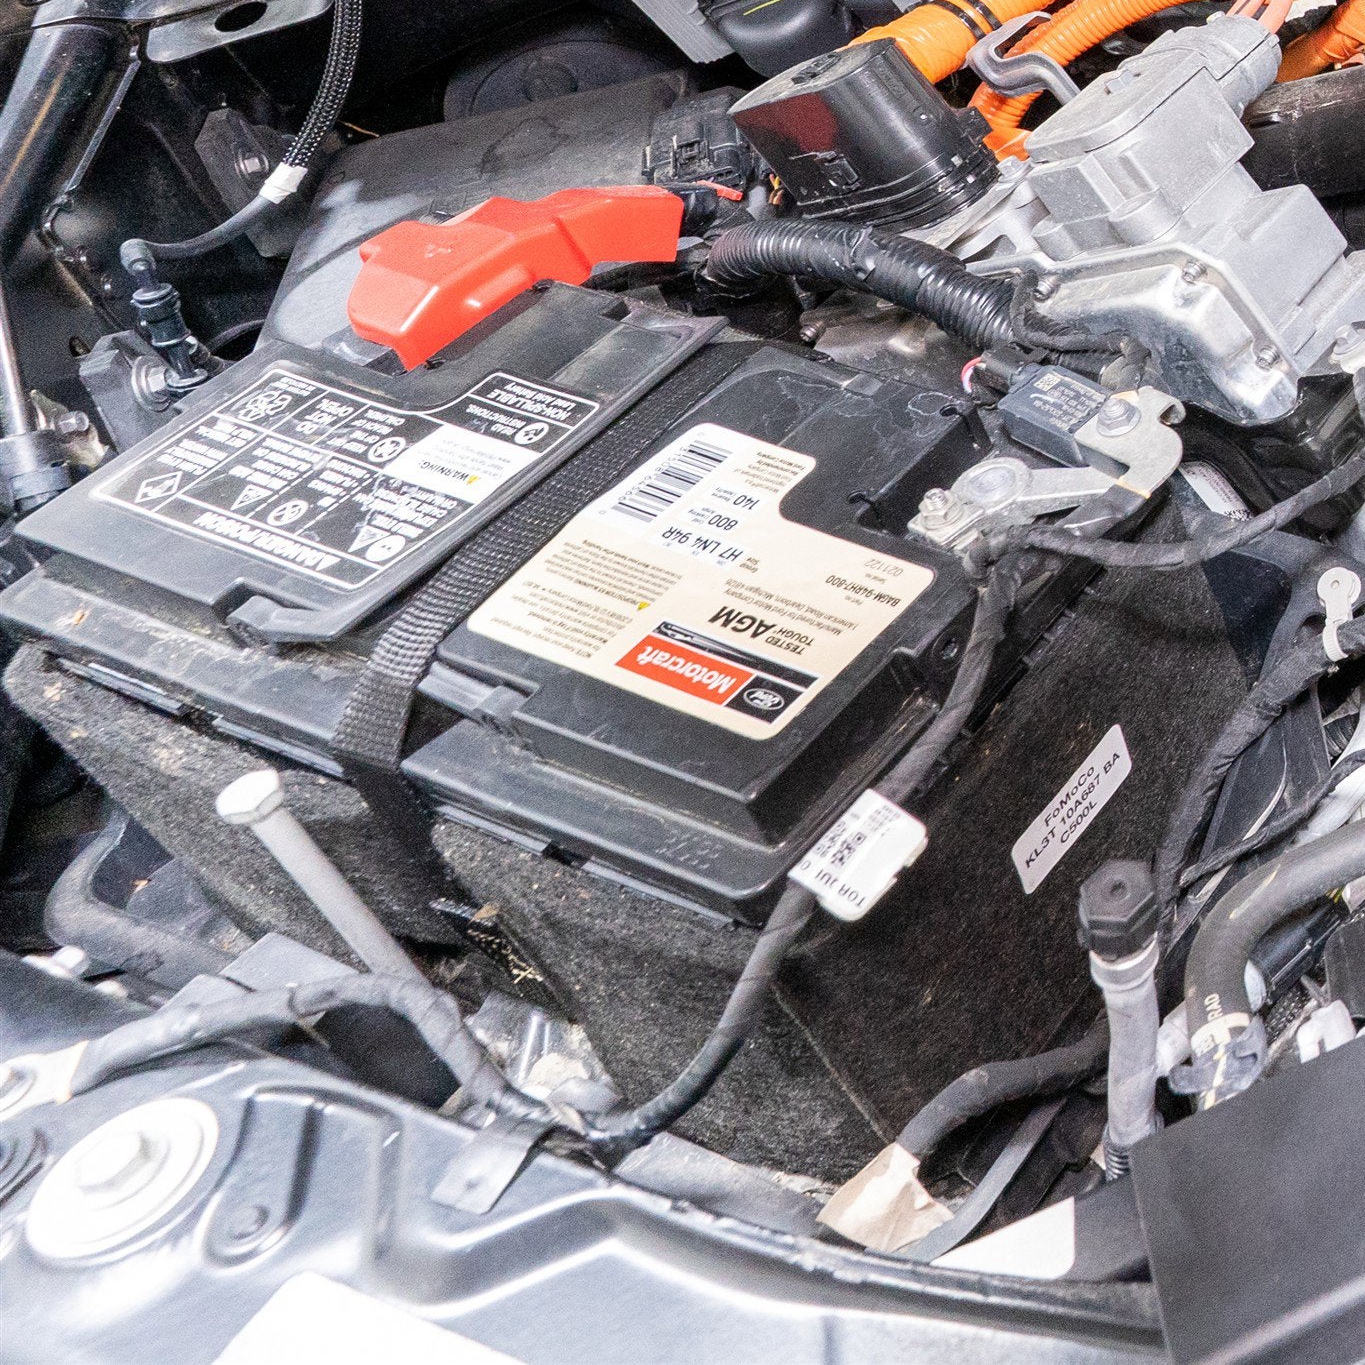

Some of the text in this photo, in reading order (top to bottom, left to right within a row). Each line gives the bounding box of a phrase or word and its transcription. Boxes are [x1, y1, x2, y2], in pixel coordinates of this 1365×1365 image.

[311, 398, 356, 417] OPEN.
[484, 388, 573, 420] NON-SPILLABLE
[501, 381, 577, 410] Lead Acid Battery
[292, 419, 322, 434] DO
[303, 409, 338, 425] NOT
[350, 417, 394, 435] REACH OF
[461, 403, 528, 428] INSTRUCTIONS.
[488, 423, 517, 435] READ
[414, 459, 471, 481] WARNING:
[730, 493, 761, 510] 140
[705, 513, 739, 531] 800
[190, 510, 328, 566] DANGER/POISON
[659, 526, 744, 561] H7 LN4 94R
[863, 557, 905, 577] 021122
[823, 574, 902, 607] BAGM-94RH7-800
[706, 605, 777, 641] AGM
[763, 635, 807, 655] TESTED
[630, 644, 739, 695] Motorcraft
[744, 689, 781, 710] Ford
[1044, 765, 1095, 827] FoMoCo
[1025, 752, 1120, 868] KL3T 10A687 BA
[1059, 798, 1097, 844] C500L
[1204, 992, 1223, 1021] RAD
